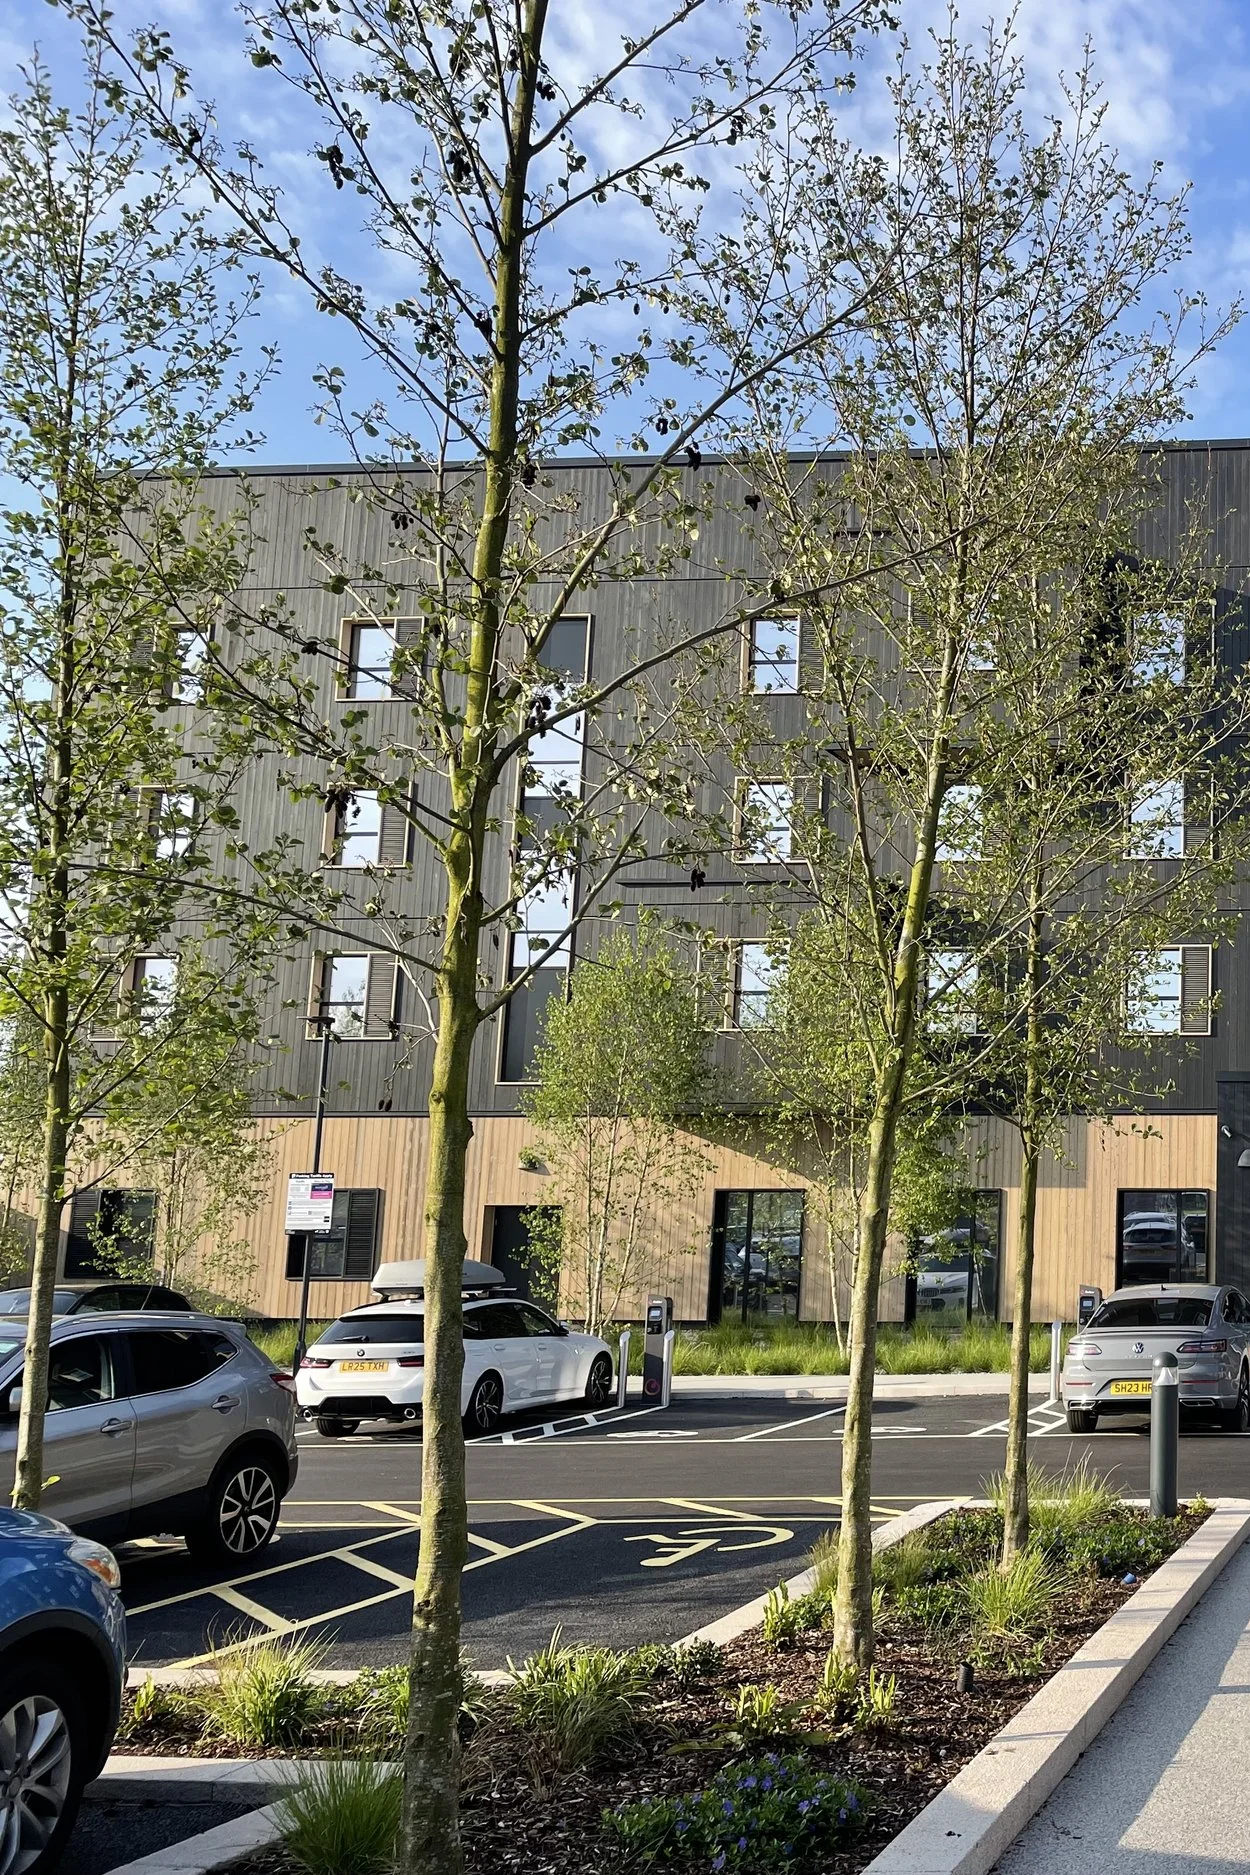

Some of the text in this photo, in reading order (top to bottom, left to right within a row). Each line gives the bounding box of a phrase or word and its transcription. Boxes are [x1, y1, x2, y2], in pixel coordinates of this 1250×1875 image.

[342, 1361, 385, 1371] LR25 TXH
[1114, 1383, 1153, 1393] SH23 HR
